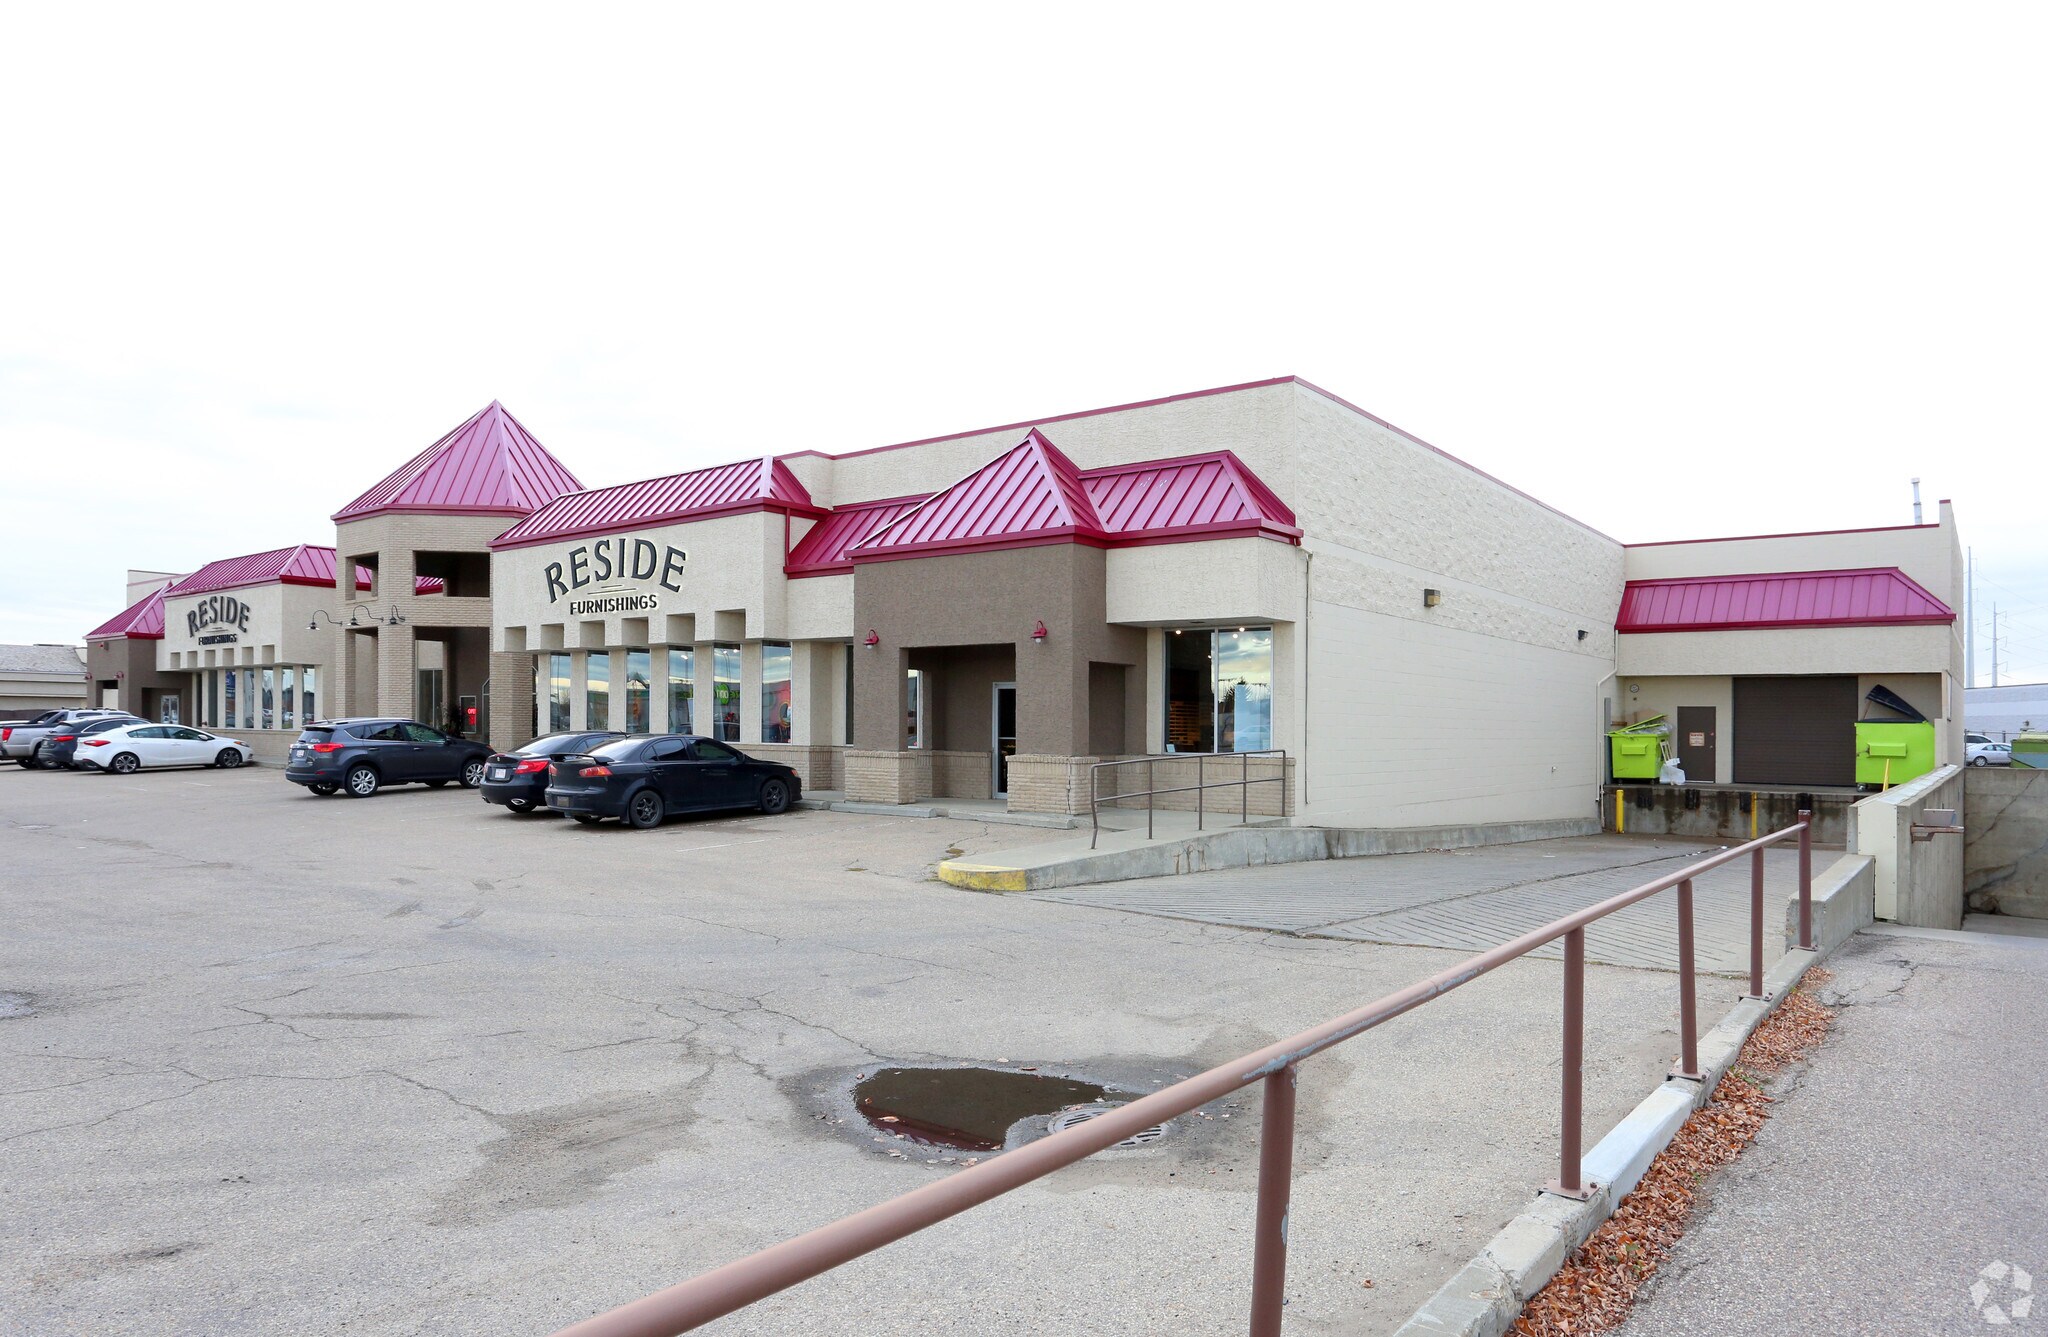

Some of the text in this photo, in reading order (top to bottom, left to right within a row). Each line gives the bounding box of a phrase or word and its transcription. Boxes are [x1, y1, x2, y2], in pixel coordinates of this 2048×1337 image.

[544, 538, 687, 603] RESIDE
[187, 596, 250, 638] RESIDE
[570, 594, 657, 615] FURNISHINGS
